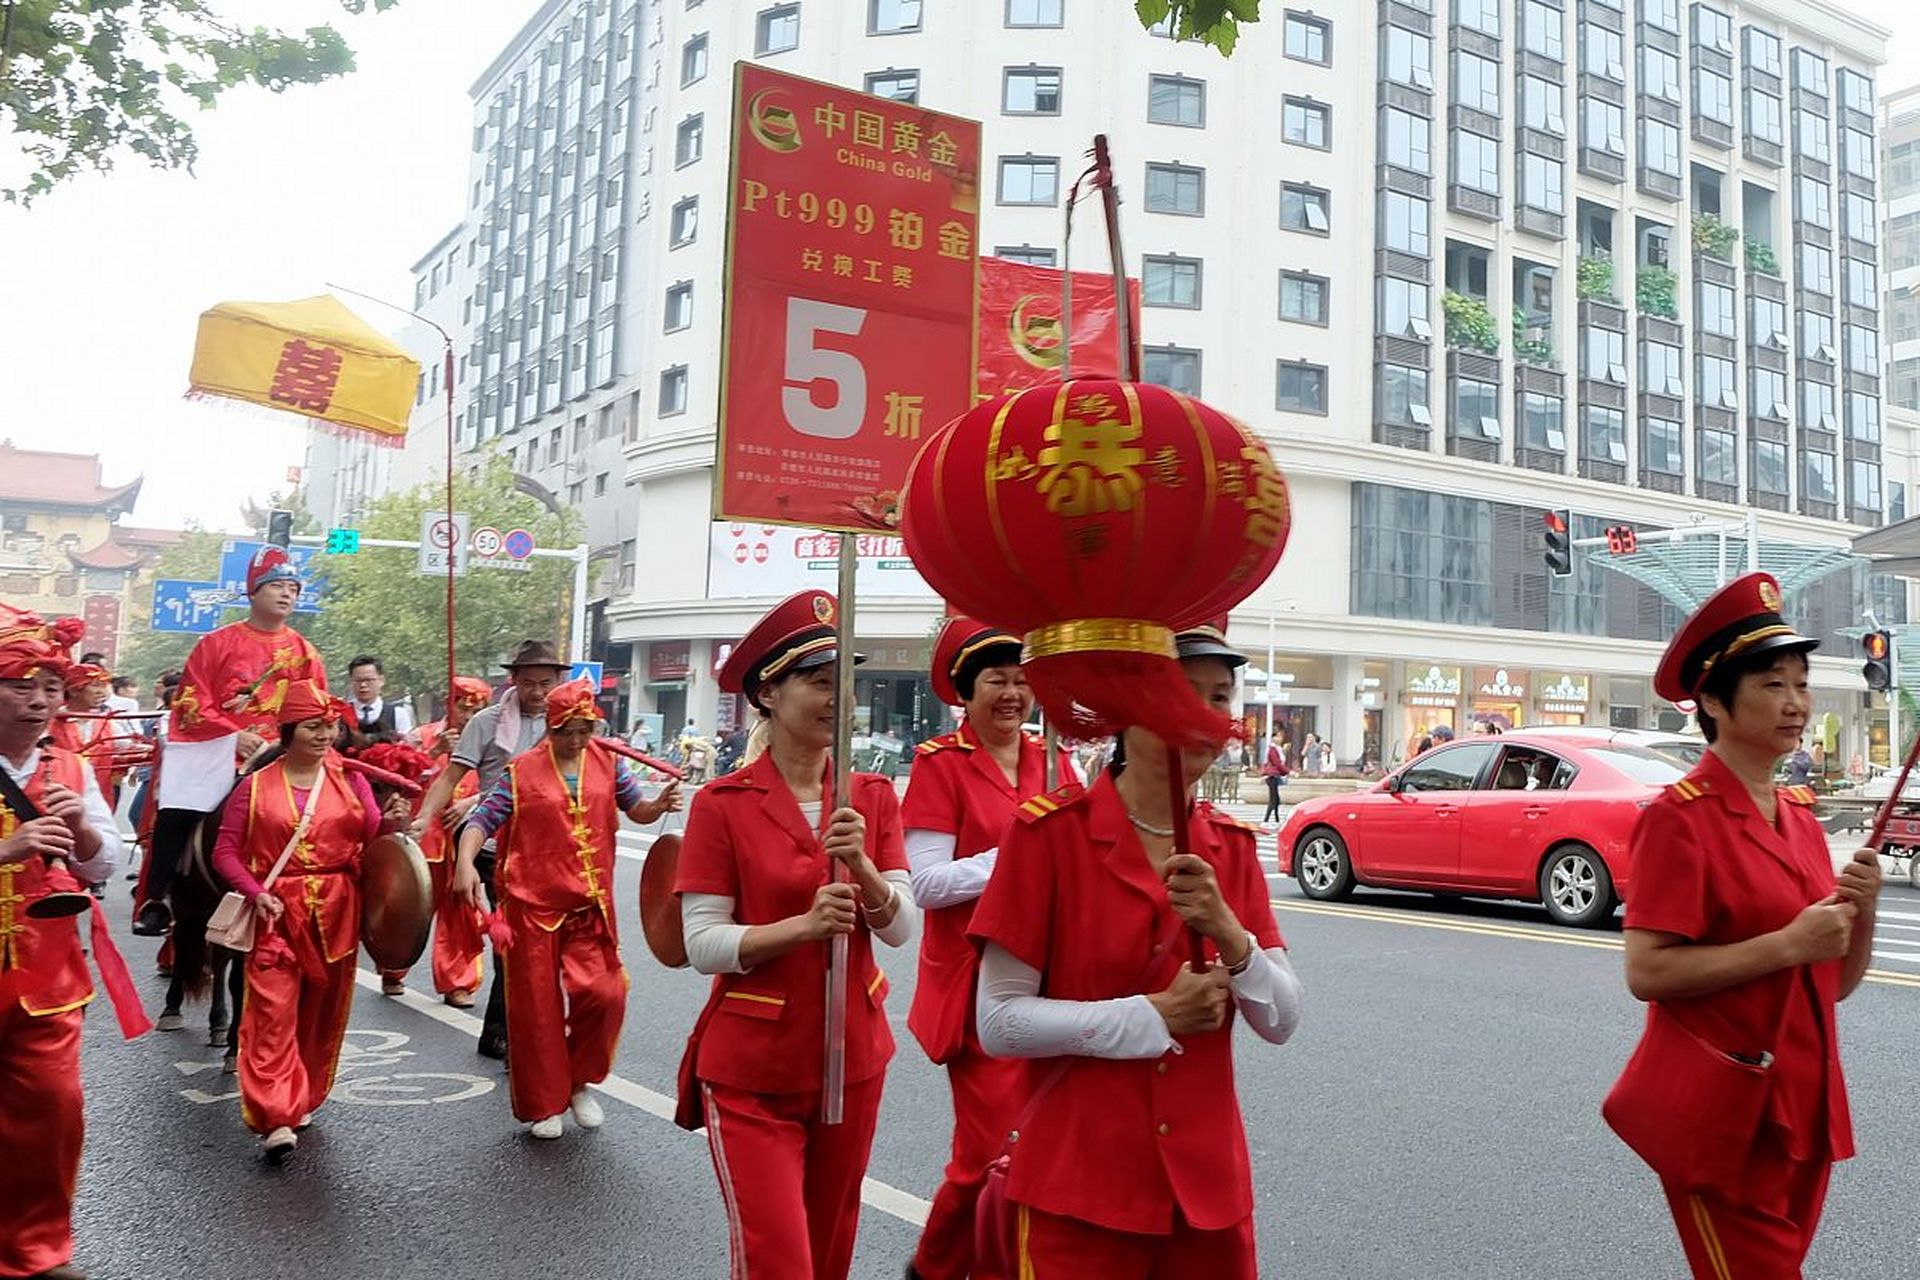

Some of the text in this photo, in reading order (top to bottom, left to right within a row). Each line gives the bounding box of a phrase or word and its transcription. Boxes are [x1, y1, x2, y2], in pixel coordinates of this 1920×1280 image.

[814, 102, 960, 167] 中国黄金
[836, 147, 933, 183] China Gold
[741, 180, 972, 261] Pt999 铂金
[801, 248, 914, 289] 兑换工费
[782, 296, 925, 440] 5 折
[478, 535, 497, 550] 50
